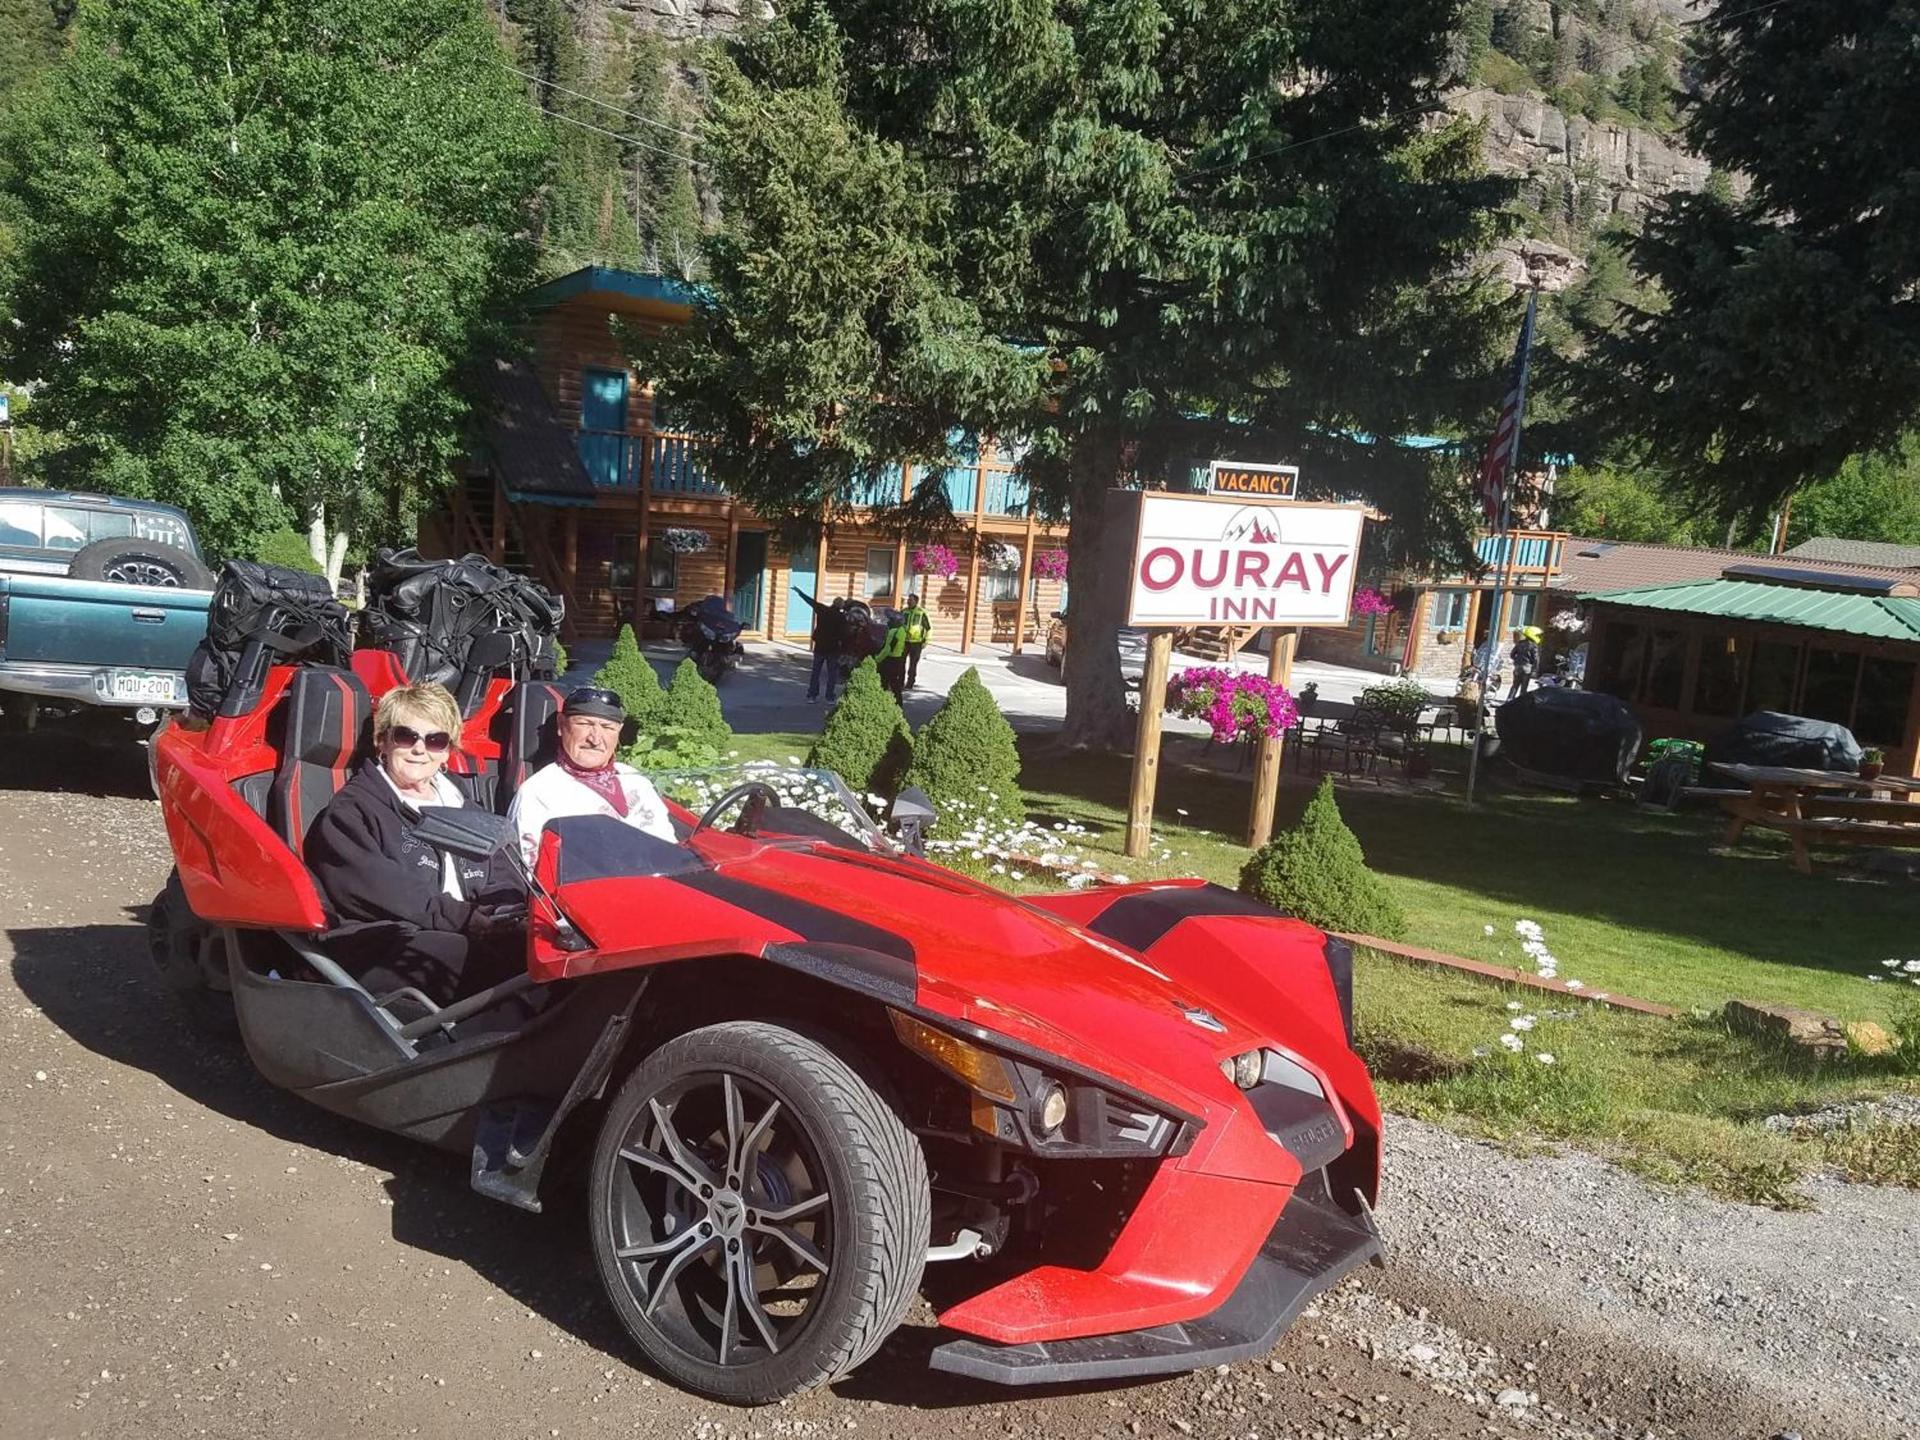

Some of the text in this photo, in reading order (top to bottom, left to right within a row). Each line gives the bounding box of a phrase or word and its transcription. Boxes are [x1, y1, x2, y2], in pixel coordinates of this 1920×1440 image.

[1218, 471, 1291, 494] VACANCY
[1140, 546, 1349, 594] OURAY
[1209, 597, 1276, 620] INN
